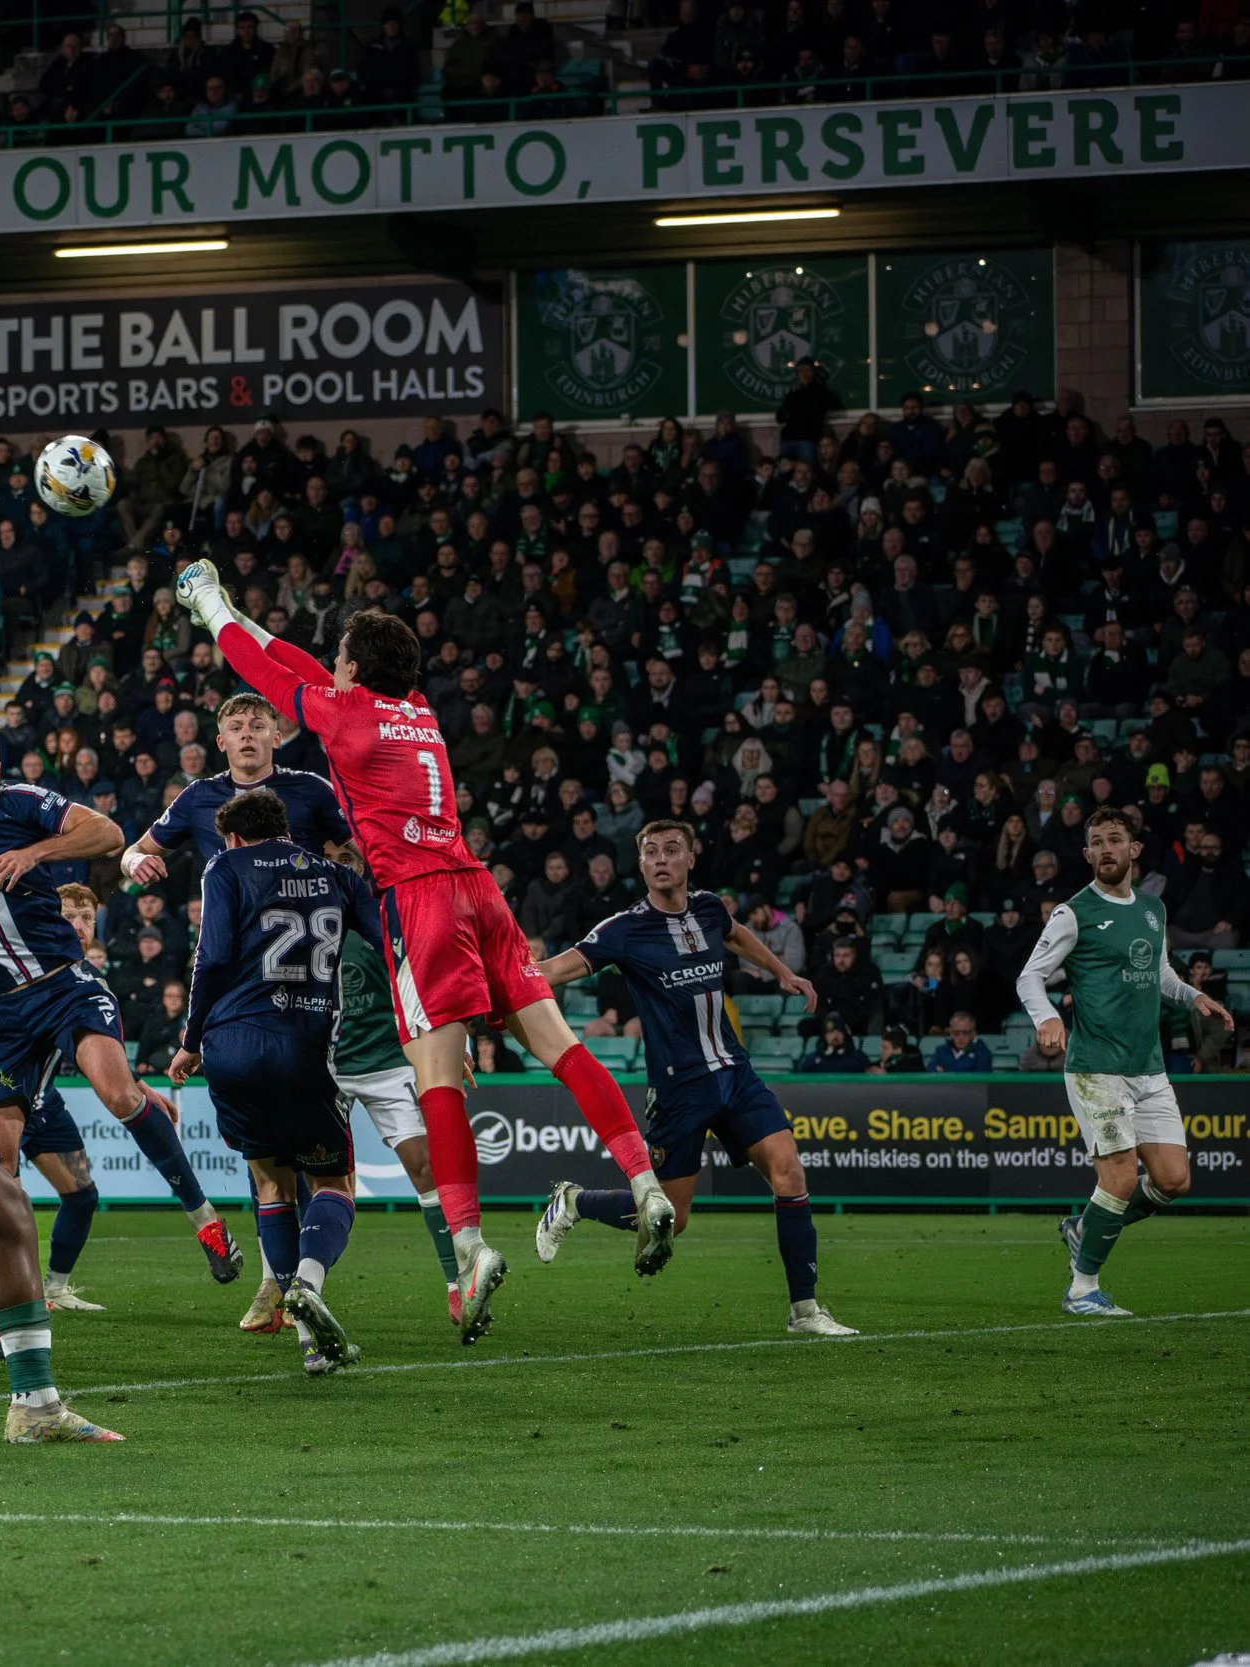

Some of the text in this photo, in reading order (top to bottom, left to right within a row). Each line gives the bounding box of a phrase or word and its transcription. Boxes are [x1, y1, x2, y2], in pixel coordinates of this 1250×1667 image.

[13, 151, 195, 222] OUR
[233, 130, 593, 211] MOTTO,
[636, 94, 1185, 189] PERSEVERE
[1180, 251, 1250, 291] HIBERN
[731, 270, 835, 313] HIBERNIAN
[119, 305, 266, 368] BALL
[279, 296, 484, 360] ROOM
[1183, 347, 1250, 380] EDINBU
[127, 376, 219, 411] BARS
[229, 375, 253, 408] &
[263, 370, 364, 406] POOL
[372, 365, 485, 401] HALLS
[556, 370, 651, 406] EDINBURGH
[734, 366, 797, 399] EDINB
[417, 750, 442, 817] 1
[253, 857, 288, 868] Drain
[277, 877, 330, 898] JONES
[260, 905, 343, 984] 28
[1122, 968, 1158, 984] bevvy
[295, 995, 334, 1007] ALPHA
[342, 992, 375, 1009] vvy
[79, 1119, 211, 1140] rfect tch
[784, 1110, 859, 1141] ave.
[867, 1108, 975, 1142] Share.
[984, 1106, 1081, 1146] Samp
[102, 1152, 141, 1171] and
[799, 1149, 831, 1168] est
[836, 1148, 921, 1168] whiskies
[925, 1151, 952, 1169] on
[957, 1148, 990, 1169] the
[1071, 1147, 1095, 1167] be
[1196, 1150, 1243, 1171] app.
